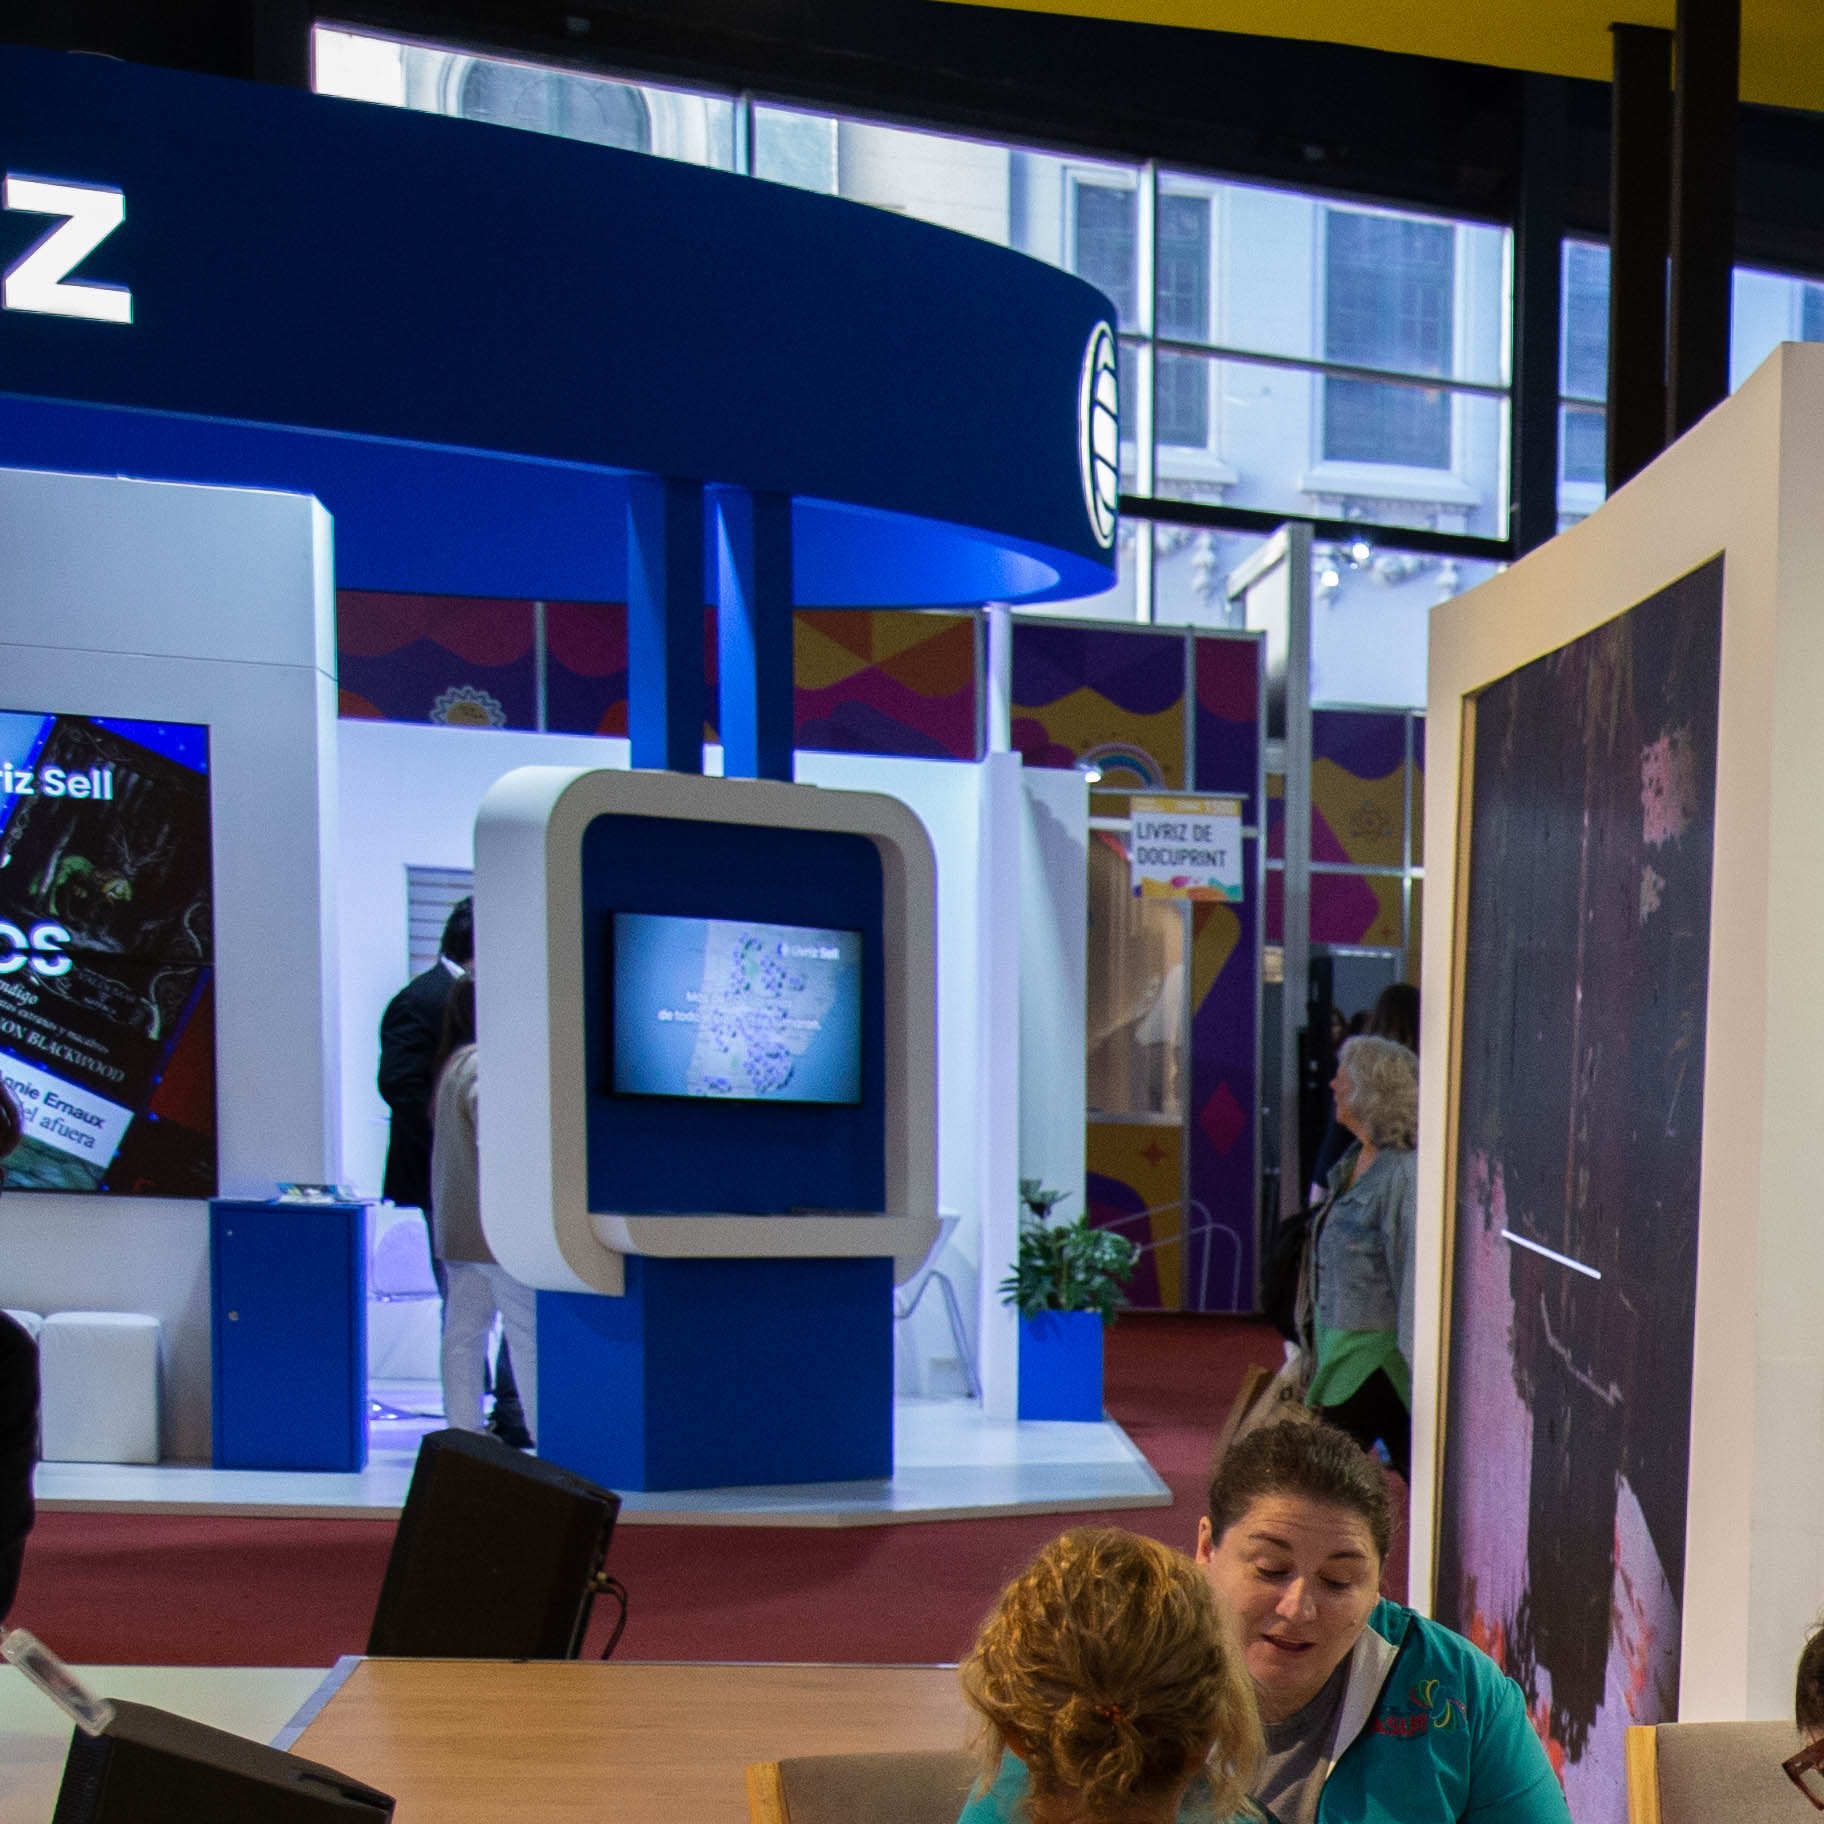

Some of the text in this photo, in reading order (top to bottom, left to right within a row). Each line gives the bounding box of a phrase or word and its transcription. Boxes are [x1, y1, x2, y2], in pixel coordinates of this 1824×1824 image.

[0, 760, 114, 801] iz Sell
[1136, 821, 1212, 843] LIVRIZ DE
[1136, 847, 1226, 868] DOCUPRINT
[0, 978, 39, 1007] ndigo
[0, 1016, 126, 1082] ON BLACKWOOD
[4, 1075, 40, 1101] nnie
[24, 1106, 97, 1150] el afuera
